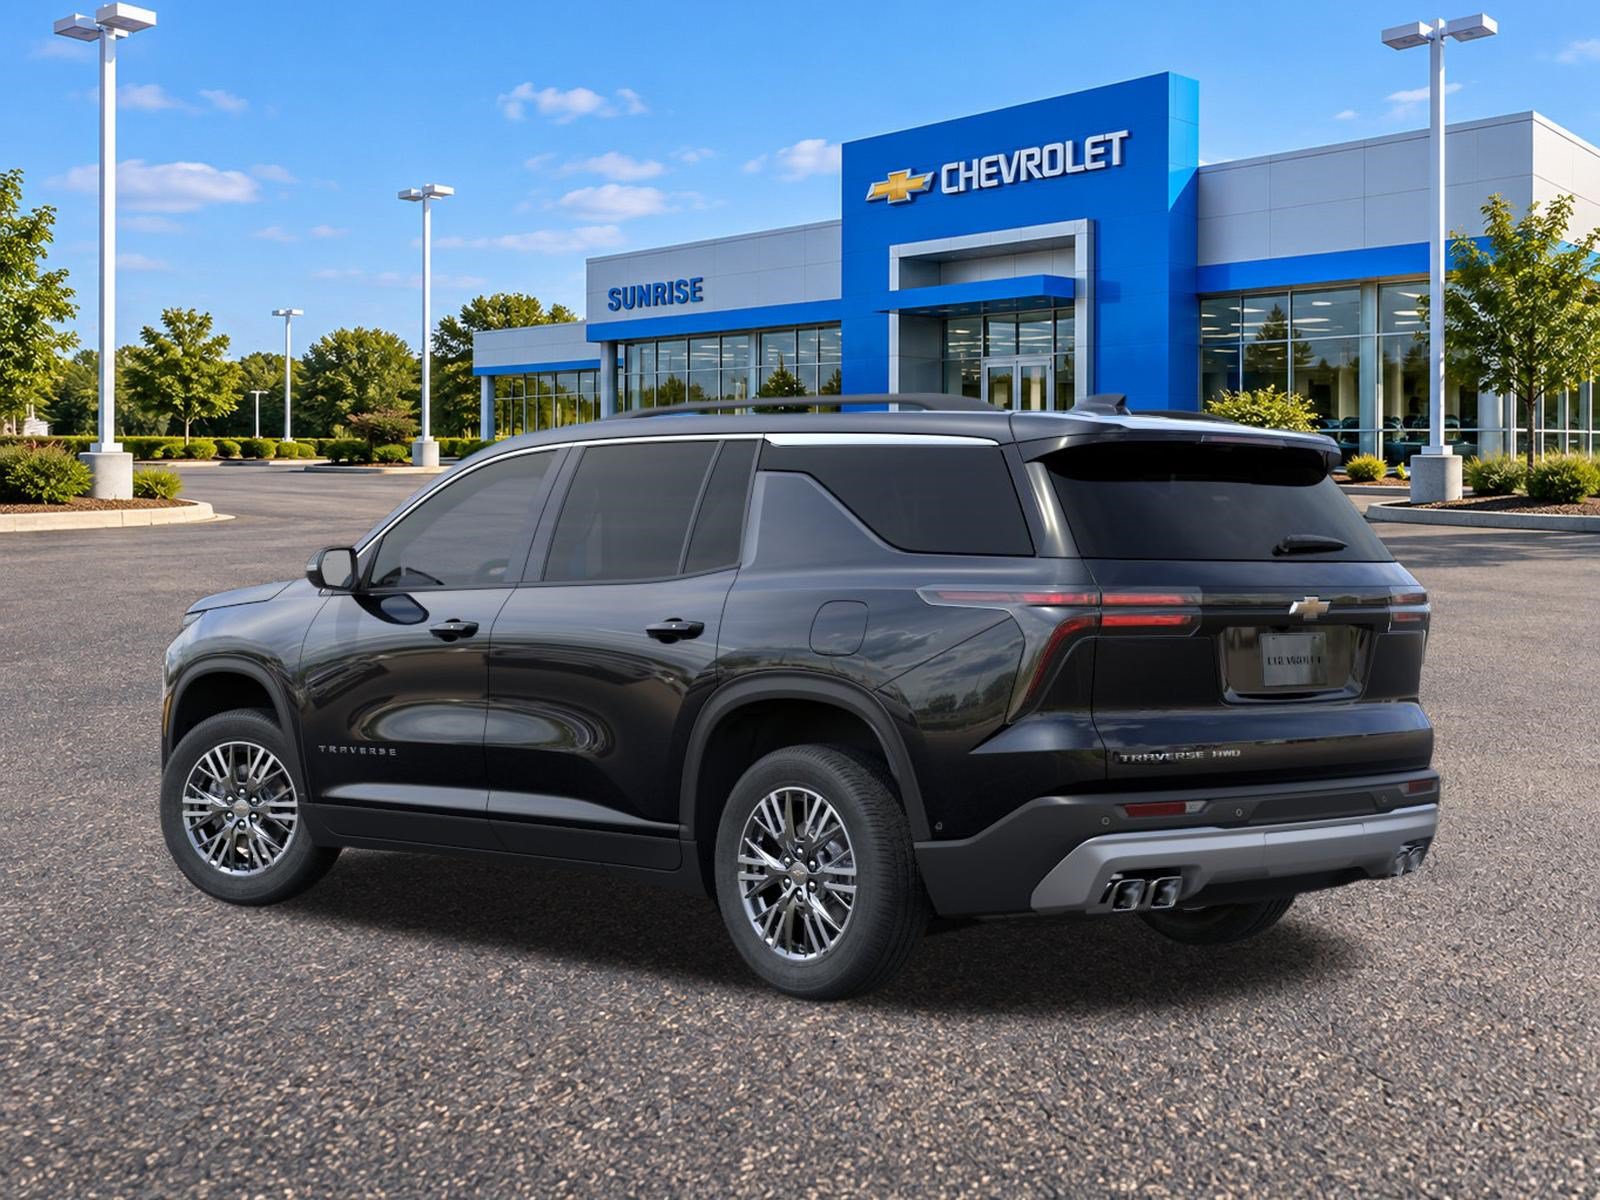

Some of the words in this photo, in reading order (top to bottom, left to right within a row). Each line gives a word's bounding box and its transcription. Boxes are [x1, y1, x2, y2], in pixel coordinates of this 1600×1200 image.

[940, 129, 1129, 195] CHEVROLET
[607, 277, 704, 312] SUNRISE
[318, 744, 397, 756] TRAVERSE
[1119, 751, 1204, 762] TRAVERSE
